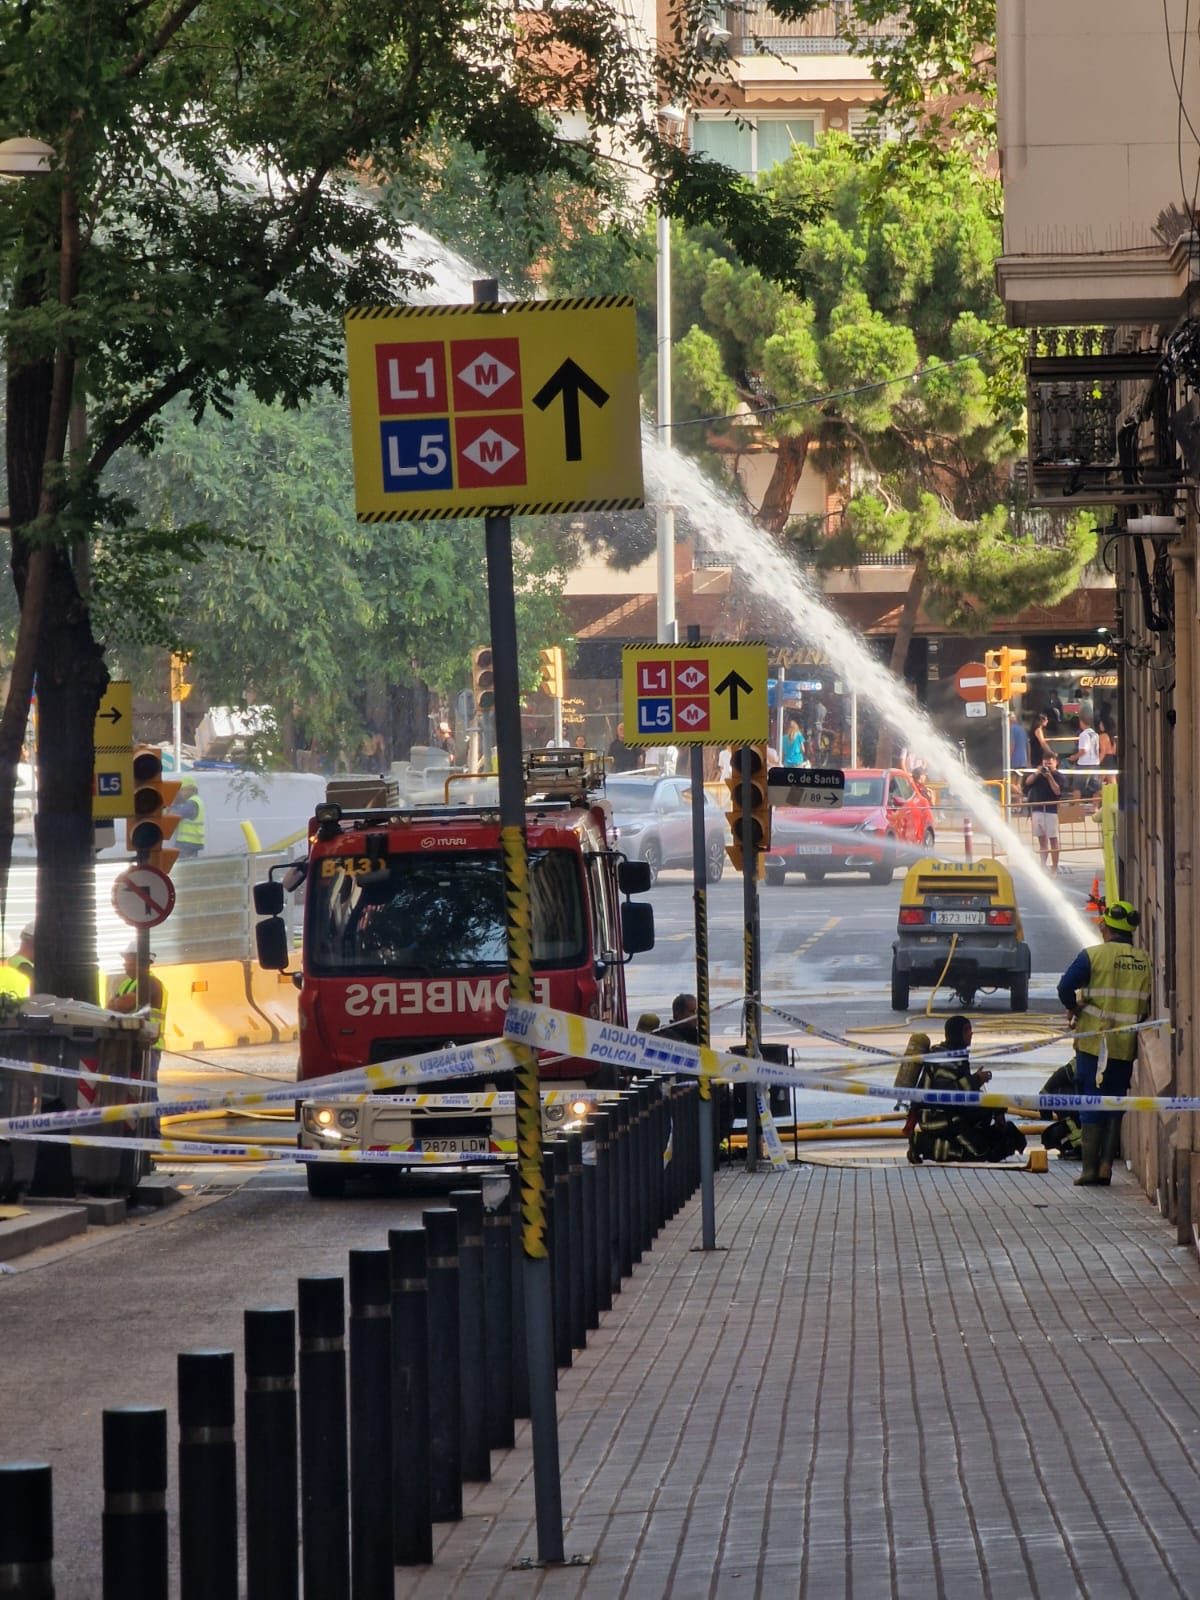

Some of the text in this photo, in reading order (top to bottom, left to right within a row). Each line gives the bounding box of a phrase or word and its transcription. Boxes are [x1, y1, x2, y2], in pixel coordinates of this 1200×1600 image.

[388, 357, 499, 400] L1 M
[387, 434, 503, 477] L5 M
[642, 668, 698, 689] L1 M
[640, 705, 699, 726] L5 M
[99, 777, 121, 792] L5
[787, 772, 841, 785] C. de Sants
[1113, 960, 1147, 971] elecnor
[590, 1043, 637, 1065] POLICIA
[423, 1139, 487, 1152] 2878 LDW
